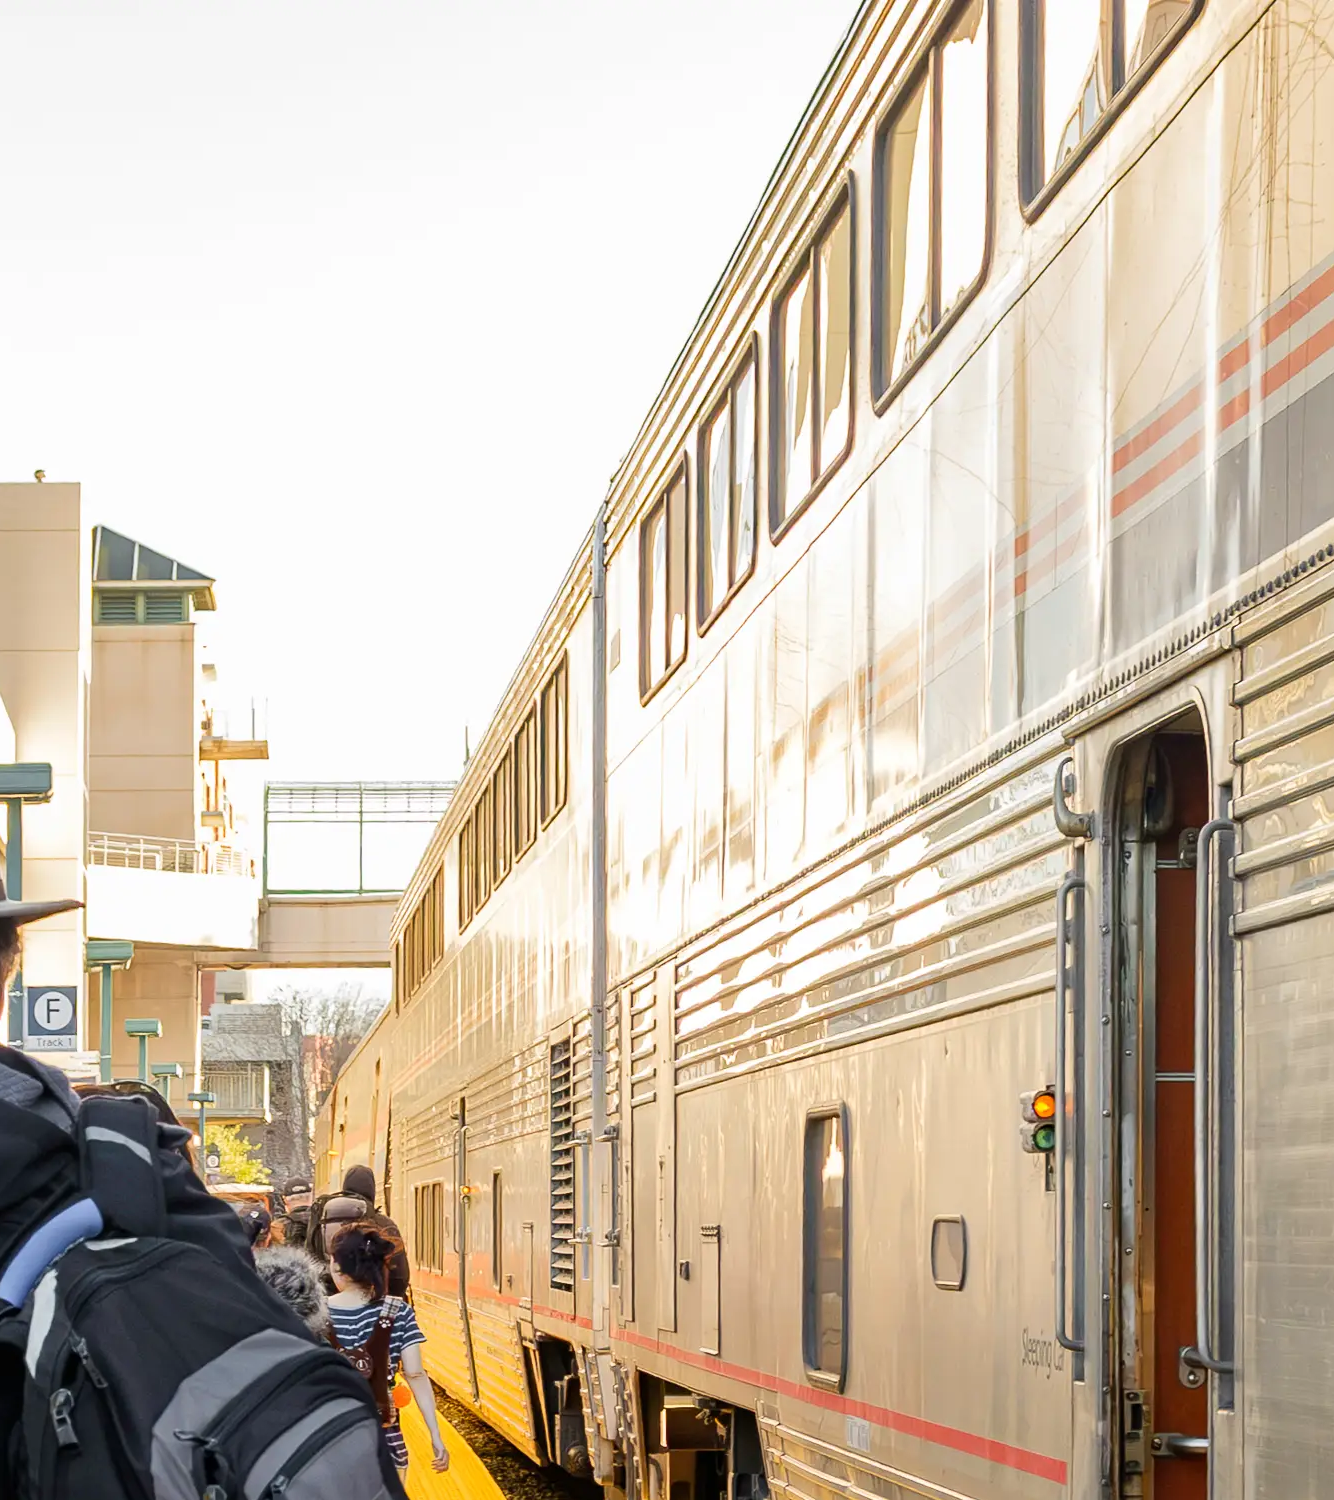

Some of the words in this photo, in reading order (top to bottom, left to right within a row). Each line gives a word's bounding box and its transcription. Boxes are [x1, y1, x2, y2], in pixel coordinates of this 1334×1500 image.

[46, 998, 60, 1024] F
[37, 1037, 64, 1047] Track
[68, 1037, 72, 1047] 1
[1021, 1327, 1052, 1380] Sleeping
